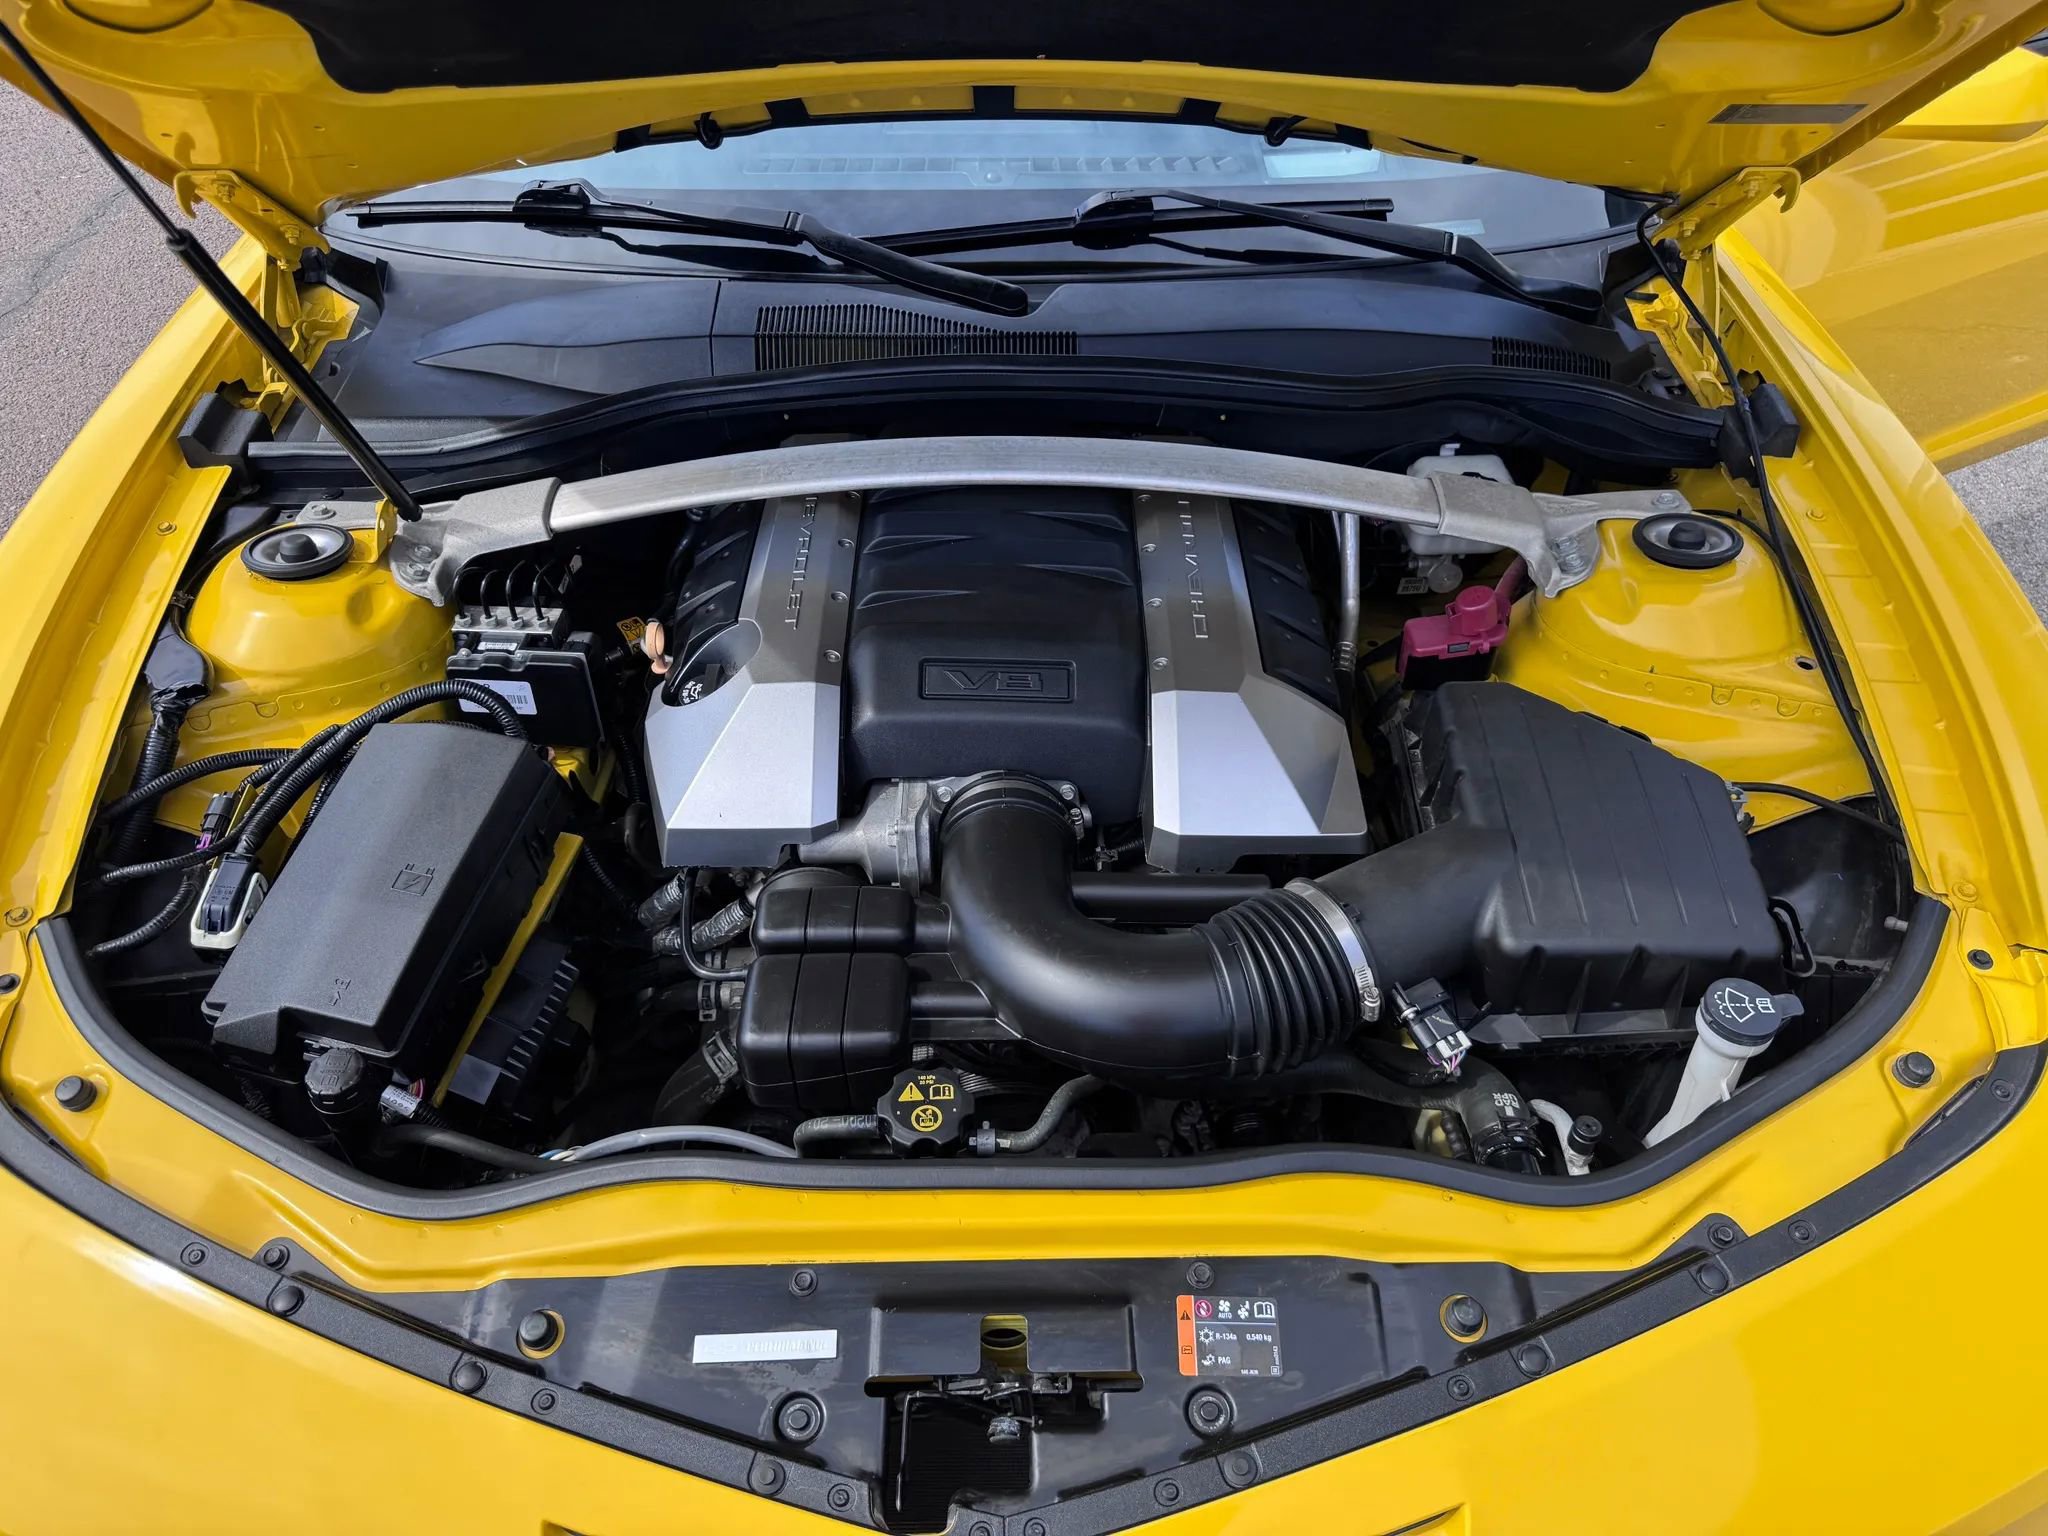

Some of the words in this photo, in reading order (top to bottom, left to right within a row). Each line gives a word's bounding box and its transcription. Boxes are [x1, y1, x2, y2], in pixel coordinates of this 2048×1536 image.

[943, 670, 1043, 691] V8
[1215, 1332, 1237, 1340] R-134a
[1263, 1333, 1272, 1343] kg
[1218, 1356, 1231, 1365] PAG
